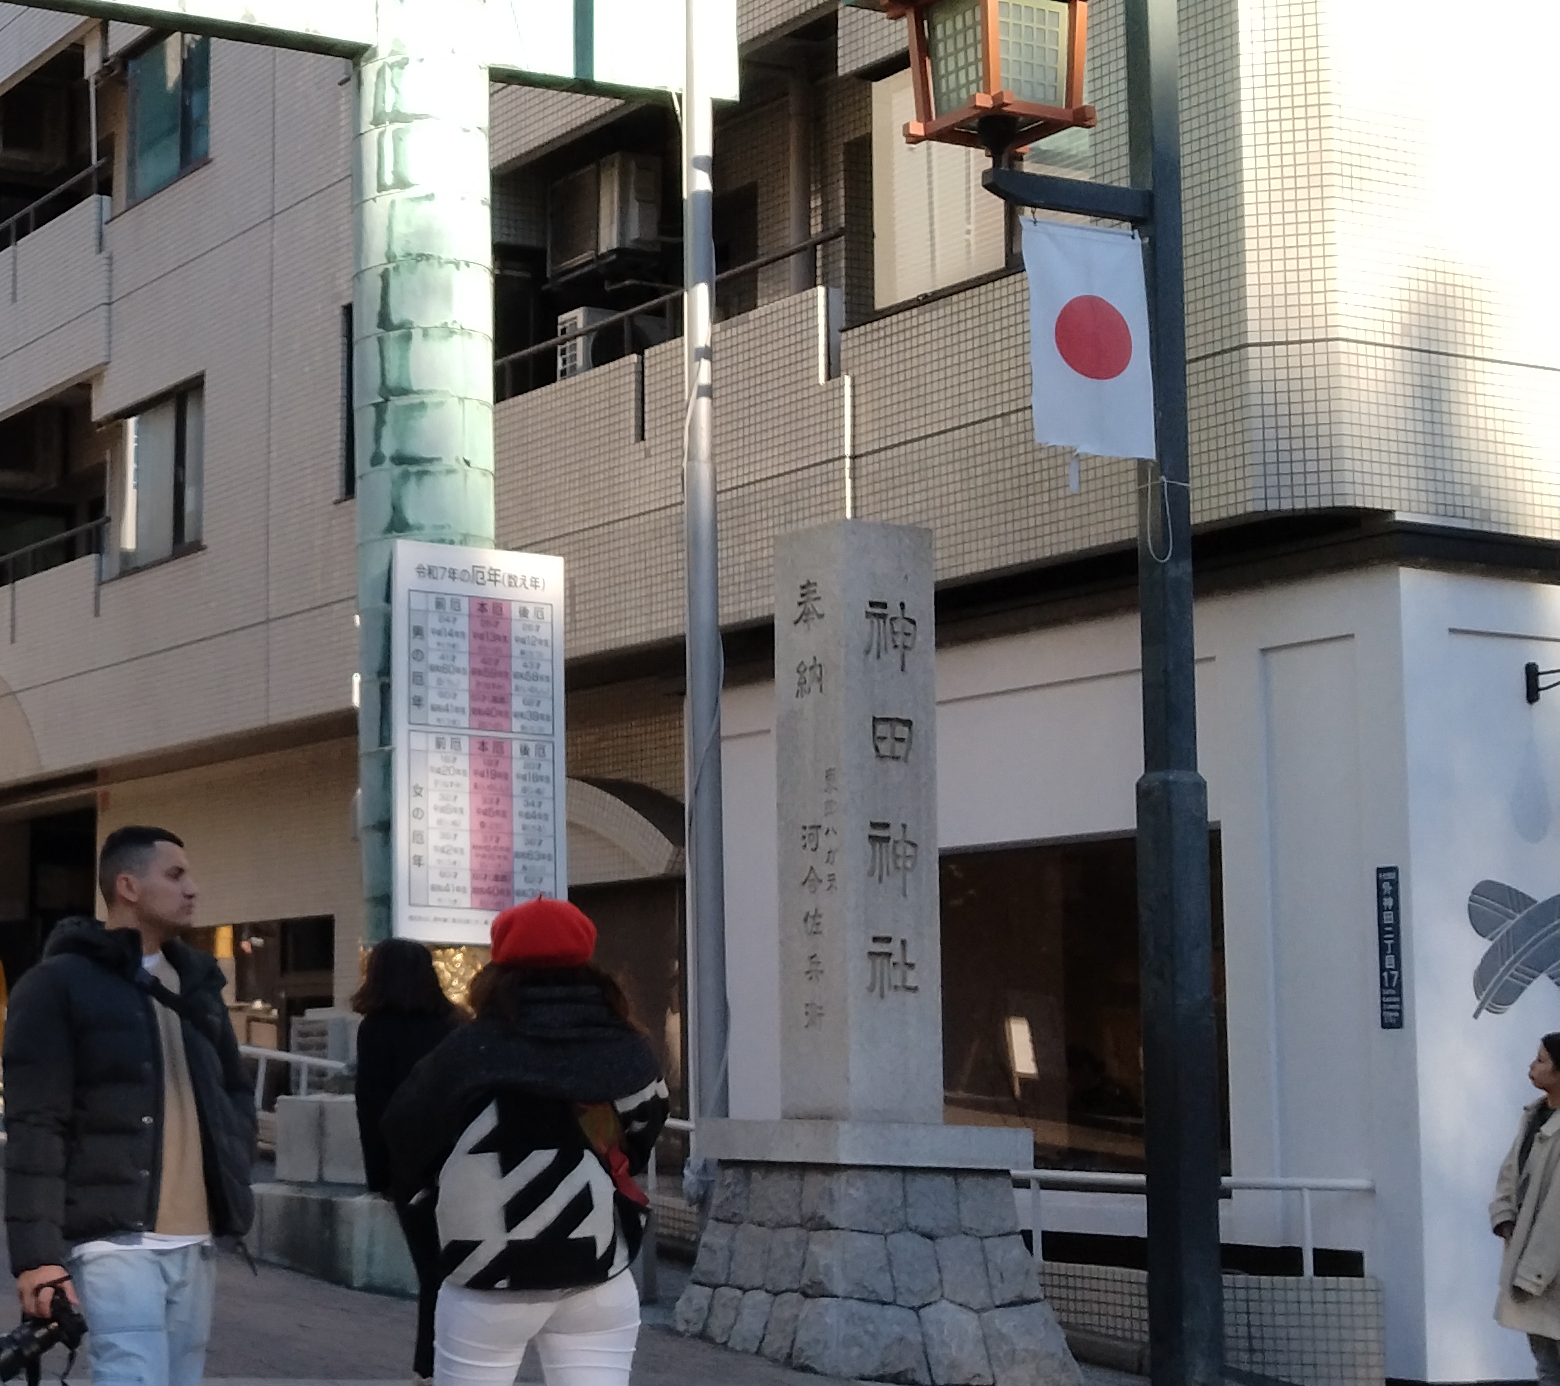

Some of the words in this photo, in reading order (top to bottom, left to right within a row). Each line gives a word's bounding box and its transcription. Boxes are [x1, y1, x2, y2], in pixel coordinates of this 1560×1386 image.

[793, 579, 824, 698] 奉納
[865, 600, 919, 999] 神田神社
[1382, 881, 1396, 968] 外神田二丁目
[1382, 970, 1399, 987] 17
